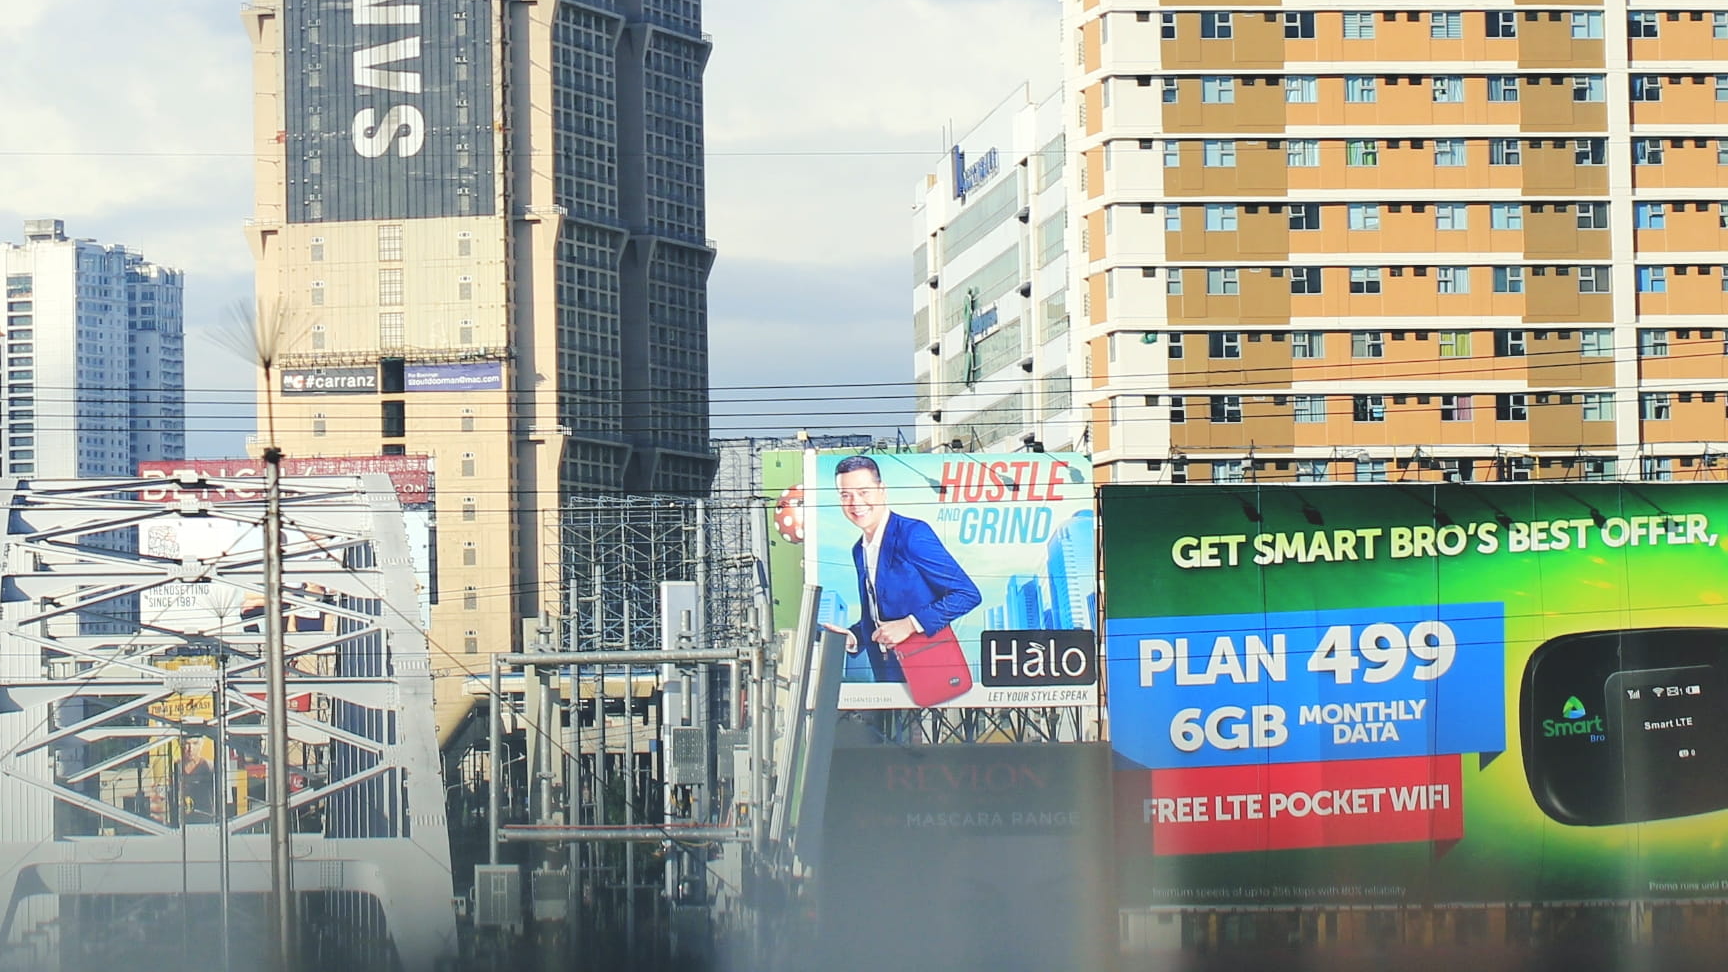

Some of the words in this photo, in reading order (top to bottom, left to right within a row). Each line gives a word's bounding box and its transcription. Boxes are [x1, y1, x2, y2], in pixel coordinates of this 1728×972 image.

[938, 460, 1069, 503] HUSTLE
[937, 507, 961, 522] AND
[959, 506, 1053, 545] GRIND
[1171, 534, 1246, 569] GET
[1253, 527, 1382, 565] SMART
[1390, 522, 1499, 559] BRO'S
[1507, 517, 1589, 552] BEST
[1600, 513, 1718, 548] OFFER,
[148, 597, 172, 608] SINCE
[176, 596, 196, 607] 1987
[1138, 634, 1287, 688] PLAN
[1307, 620, 1457, 684] 499
[988, 691, 1005, 702] LET
[1006, 691, 1029, 702] YOUR
[1030, 690, 1057, 702] STYLE
[1058, 690, 1088, 701] SPEAK
[1299, 699, 1427, 726] MONTHLY
[1644, 719, 1673, 730] Smart
[1675, 717, 1693, 727] LTE
[1169, 704, 1289, 753] 6GB
[1333, 721, 1400, 745] DATA
[1542, 715, 1604, 737] Smart
[1590, 734, 1605, 743] Bro
[1143, 793, 1210, 824] FREE
[1214, 791, 1263, 820] LTE
[1269, 787, 1386, 819] POCKET
[1389, 783, 1450, 812] WIFI
[906, 812, 1003, 827] MASCARA
[1011, 811, 1081, 826] RANGE
[1649, 881, 1678, 892] Promo
